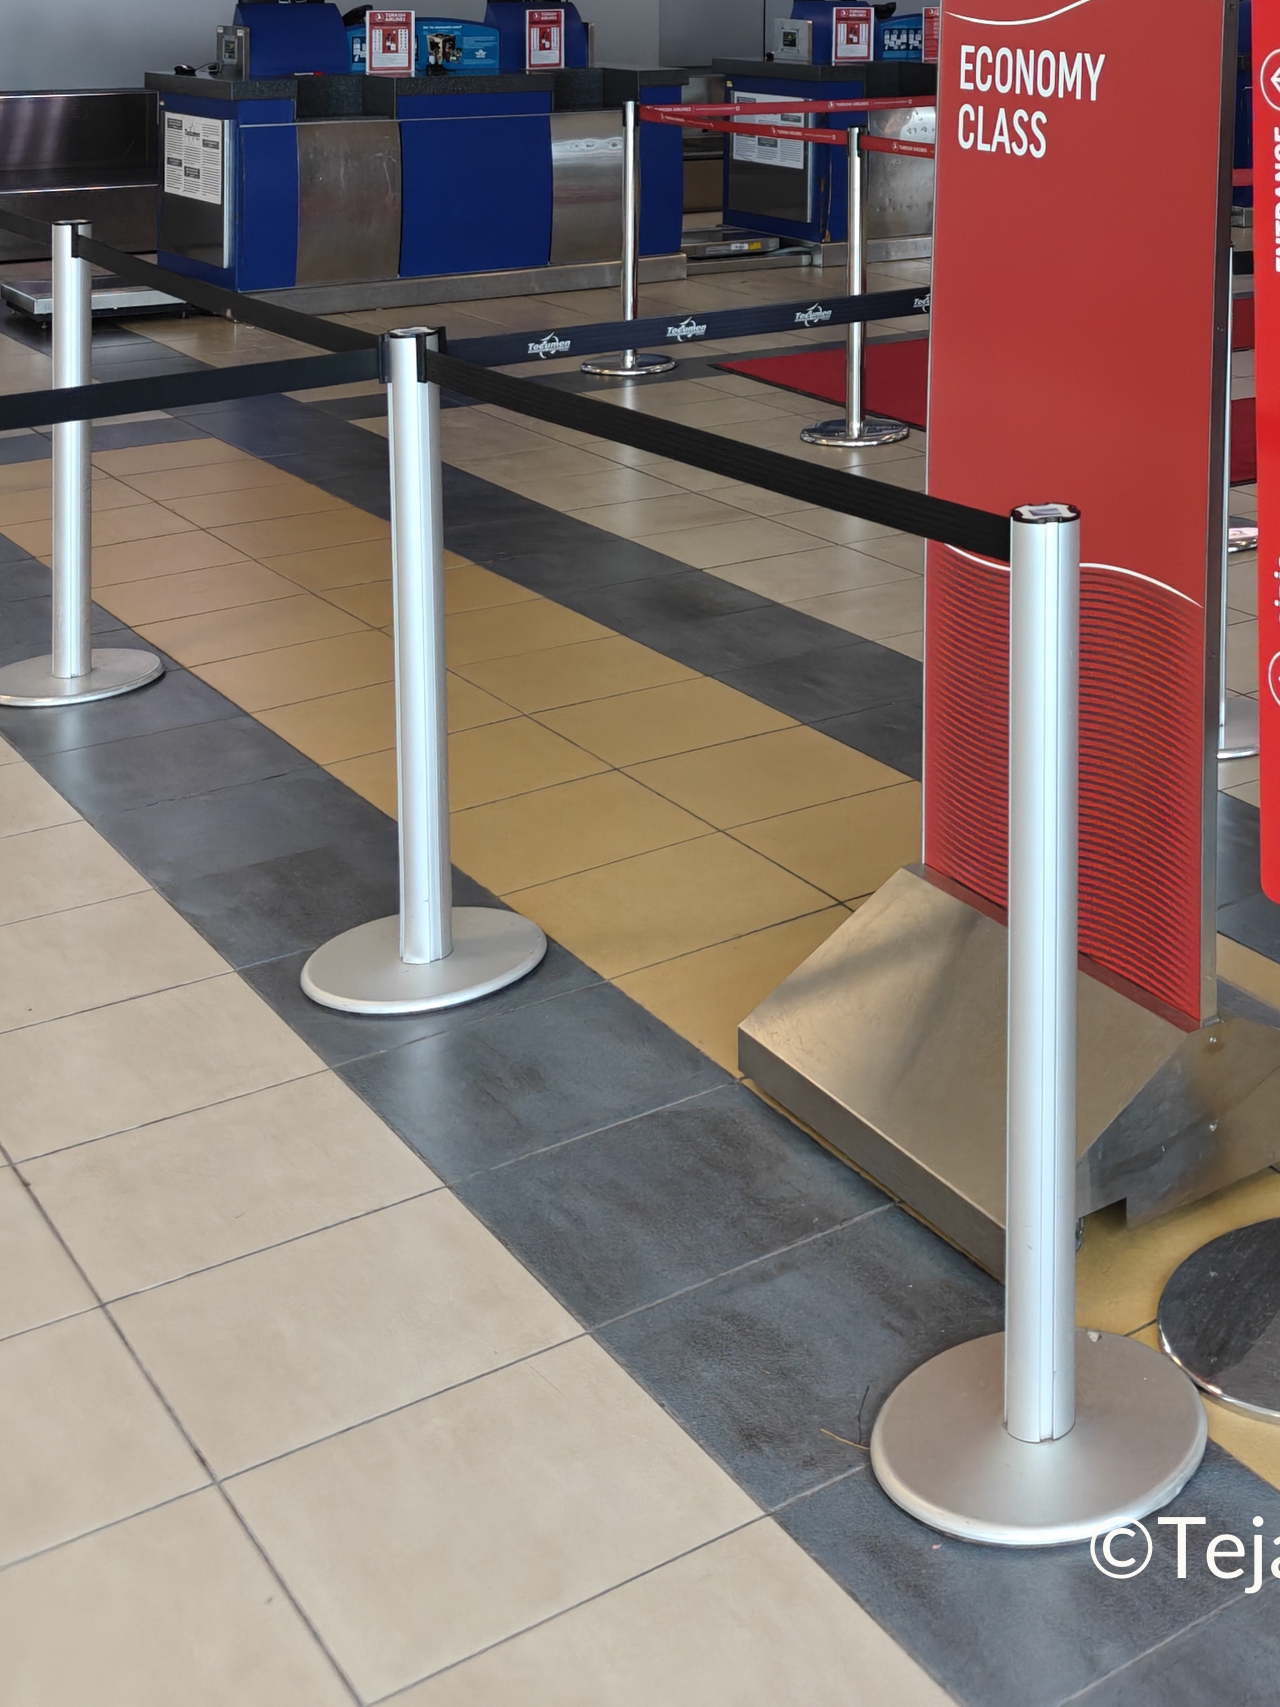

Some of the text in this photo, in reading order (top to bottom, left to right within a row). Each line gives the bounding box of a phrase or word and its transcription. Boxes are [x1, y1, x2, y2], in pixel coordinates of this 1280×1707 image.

[960, 45, 1106, 101] ECONOMY
[958, 103, 1047, 158] CLASS
[794, 307, 832, 322] Tocumen
[667, 323, 707, 337] Tocumen
[528, 339, 571, 354] Tocumen
